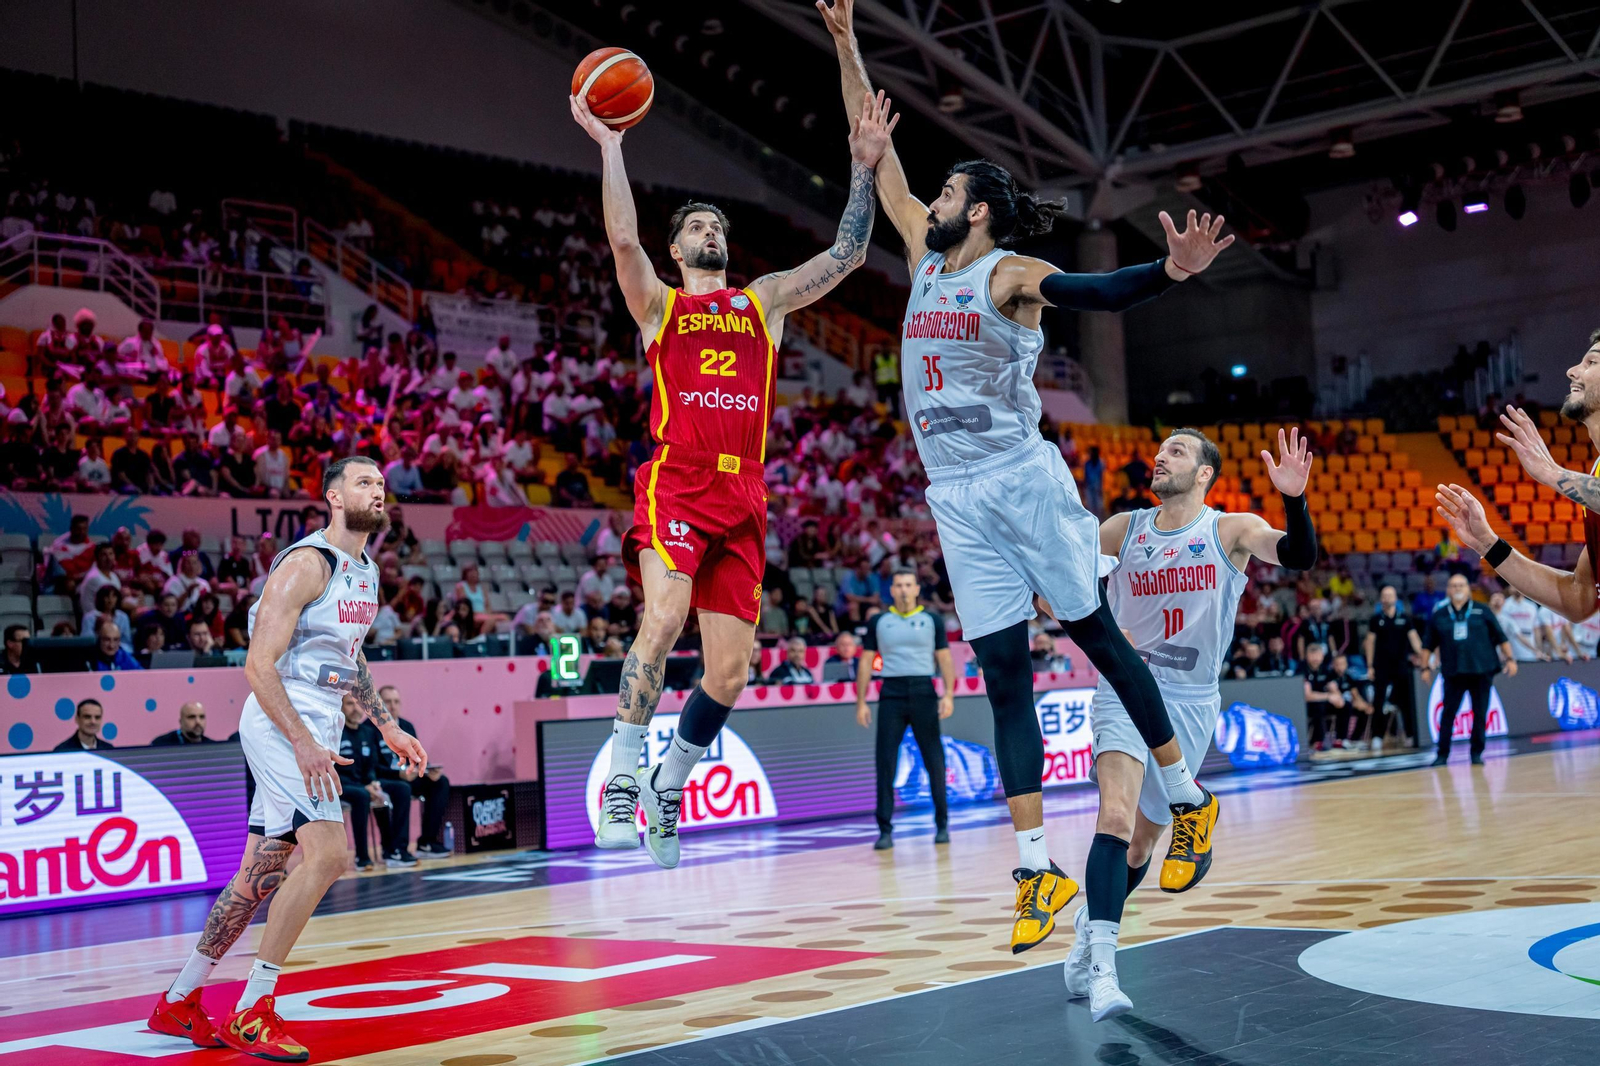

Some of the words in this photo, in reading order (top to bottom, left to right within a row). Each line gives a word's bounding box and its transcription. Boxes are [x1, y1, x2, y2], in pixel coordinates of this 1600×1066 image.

[677, 310, 756, 338] ESPAÑA
[905, 310, 981, 342] აქართველო
[700, 348, 737, 377] 22
[922, 355, 944, 392] 35
[679, 387, 759, 413] endesa
[1128, 564, 1216, 597] საქართველო
[1162, 608, 1184, 640] 10
[550, 636, 580, 680] 12
[1040, 700, 1092, 735] 百岁
[0, 768, 122, 826] 岁山
[0, 816, 182, 900] anten
[0, 953, 717, 1059] TCL
